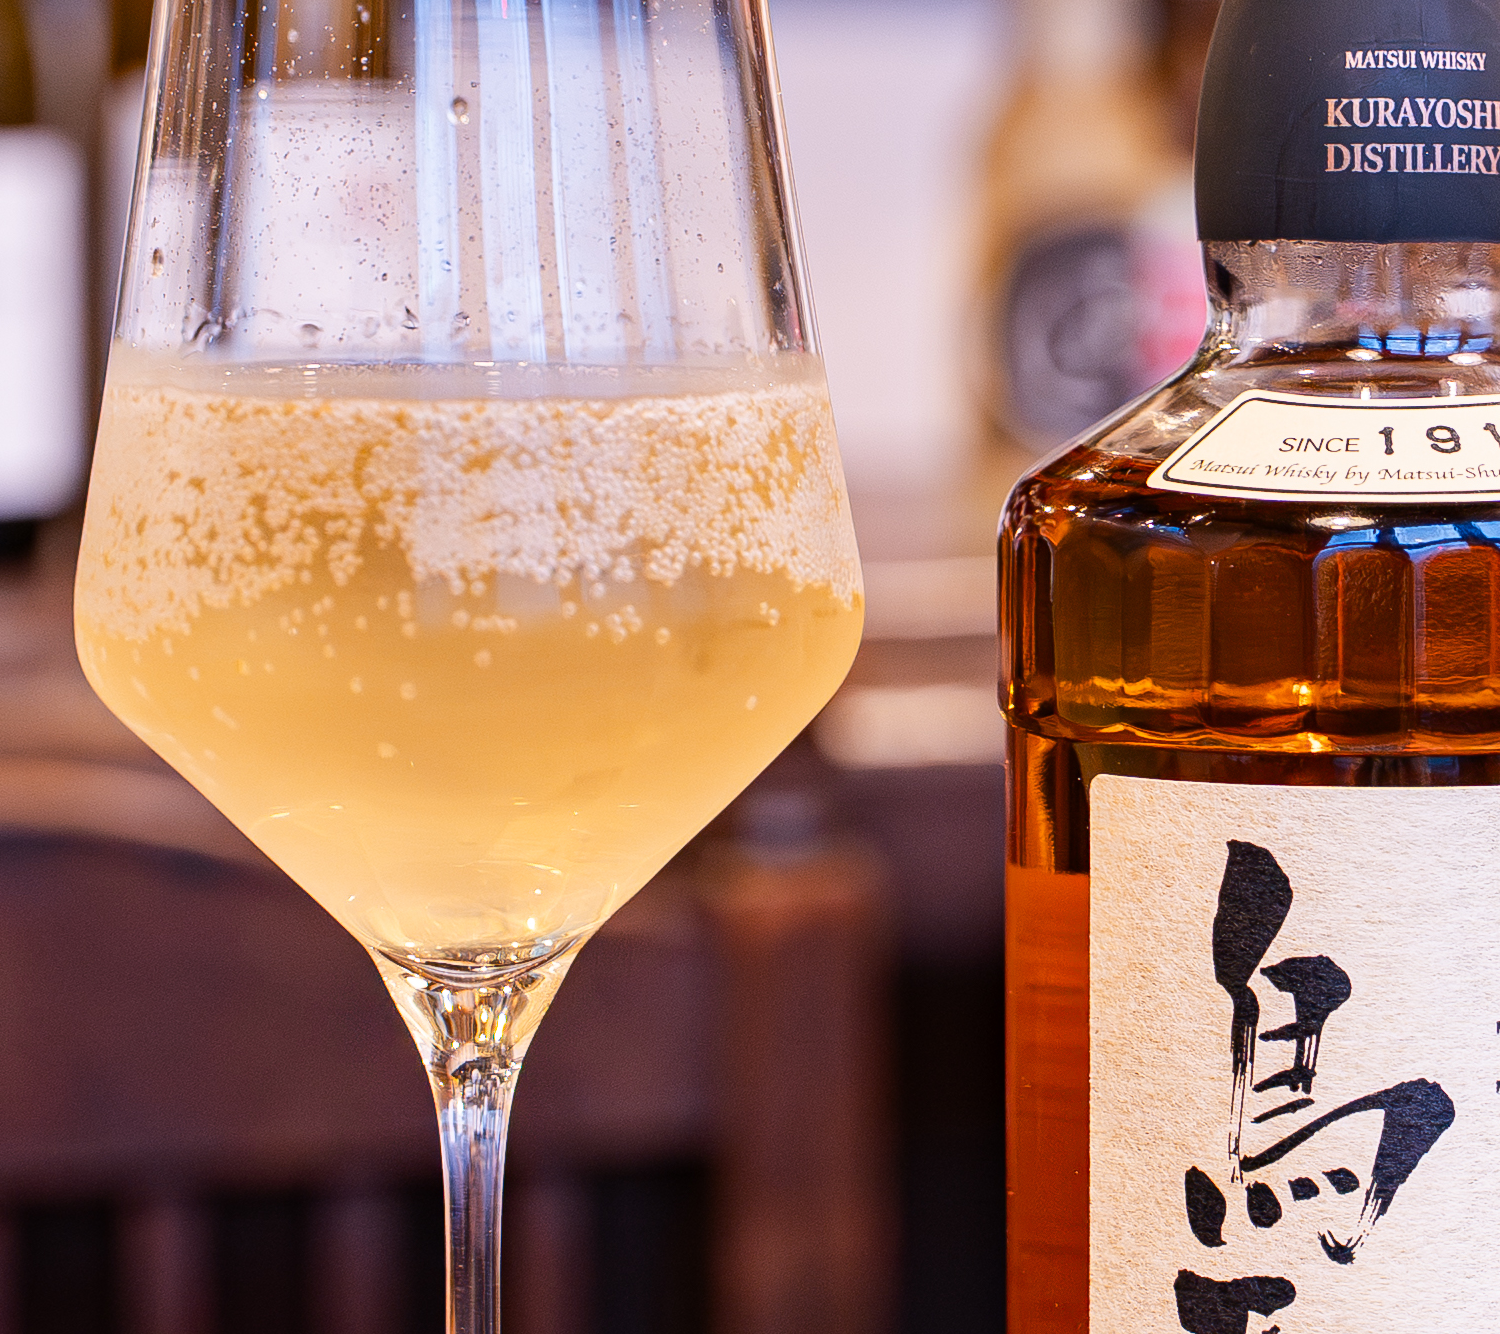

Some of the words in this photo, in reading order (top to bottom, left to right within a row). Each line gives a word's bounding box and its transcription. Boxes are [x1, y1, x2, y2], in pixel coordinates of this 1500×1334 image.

[1345, 50, 1417, 70] MATSUI
[1420, 51, 1486, 71] WHISKY
[1278, 437, 1360, 453] SINCE
[1189, 459, 1262, 476] Matsui
[1265, 464, 1338, 485] Whisky
[1345, 465, 1370, 485] by
